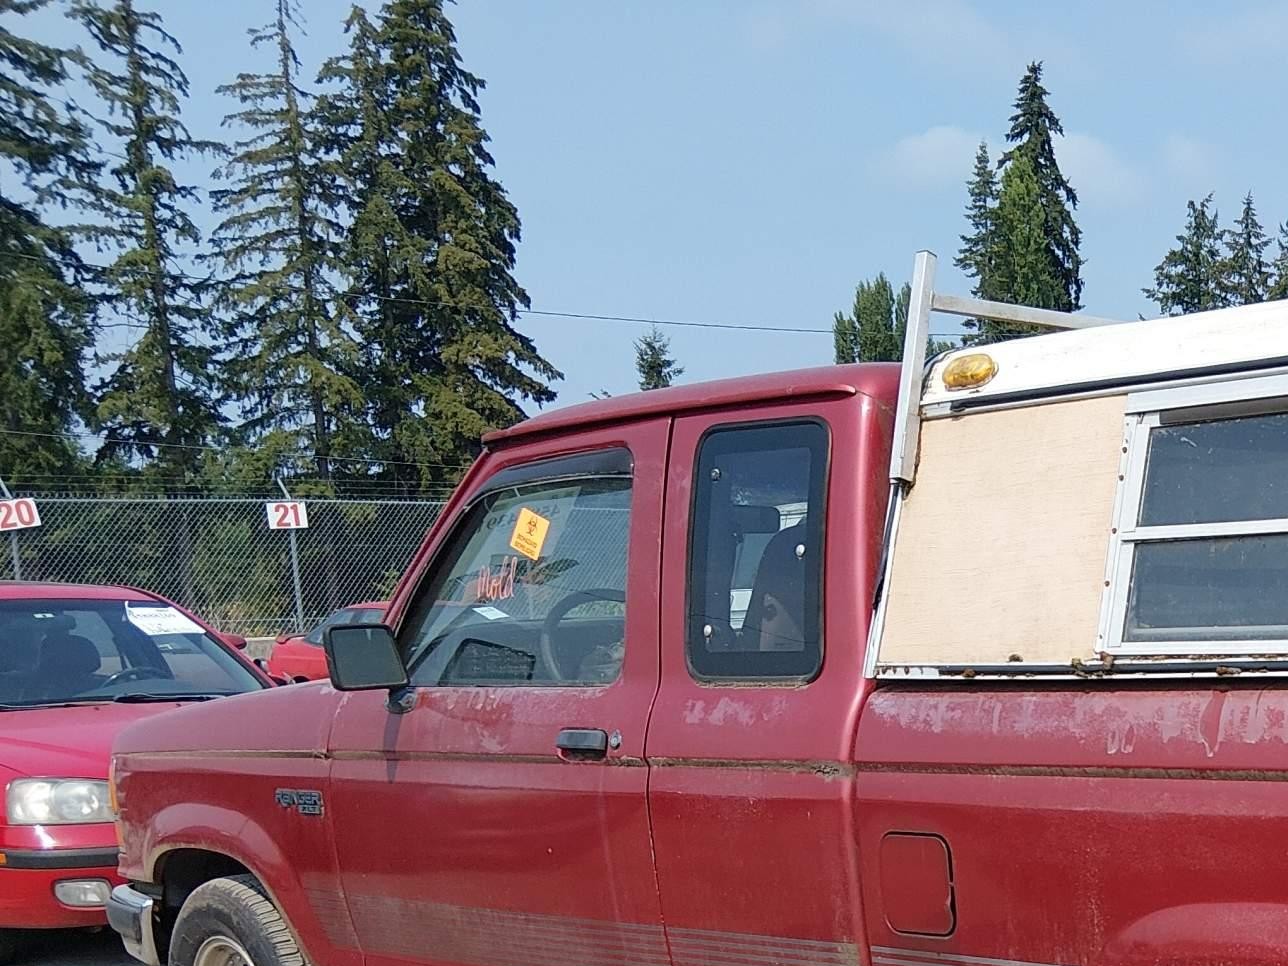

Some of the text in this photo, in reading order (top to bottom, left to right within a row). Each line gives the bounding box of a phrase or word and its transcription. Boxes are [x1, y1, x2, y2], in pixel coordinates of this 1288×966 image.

[0, 500, 35, 529] 20
[274, 503, 301, 527] 21
[275, 789, 321, 806] RANGER
